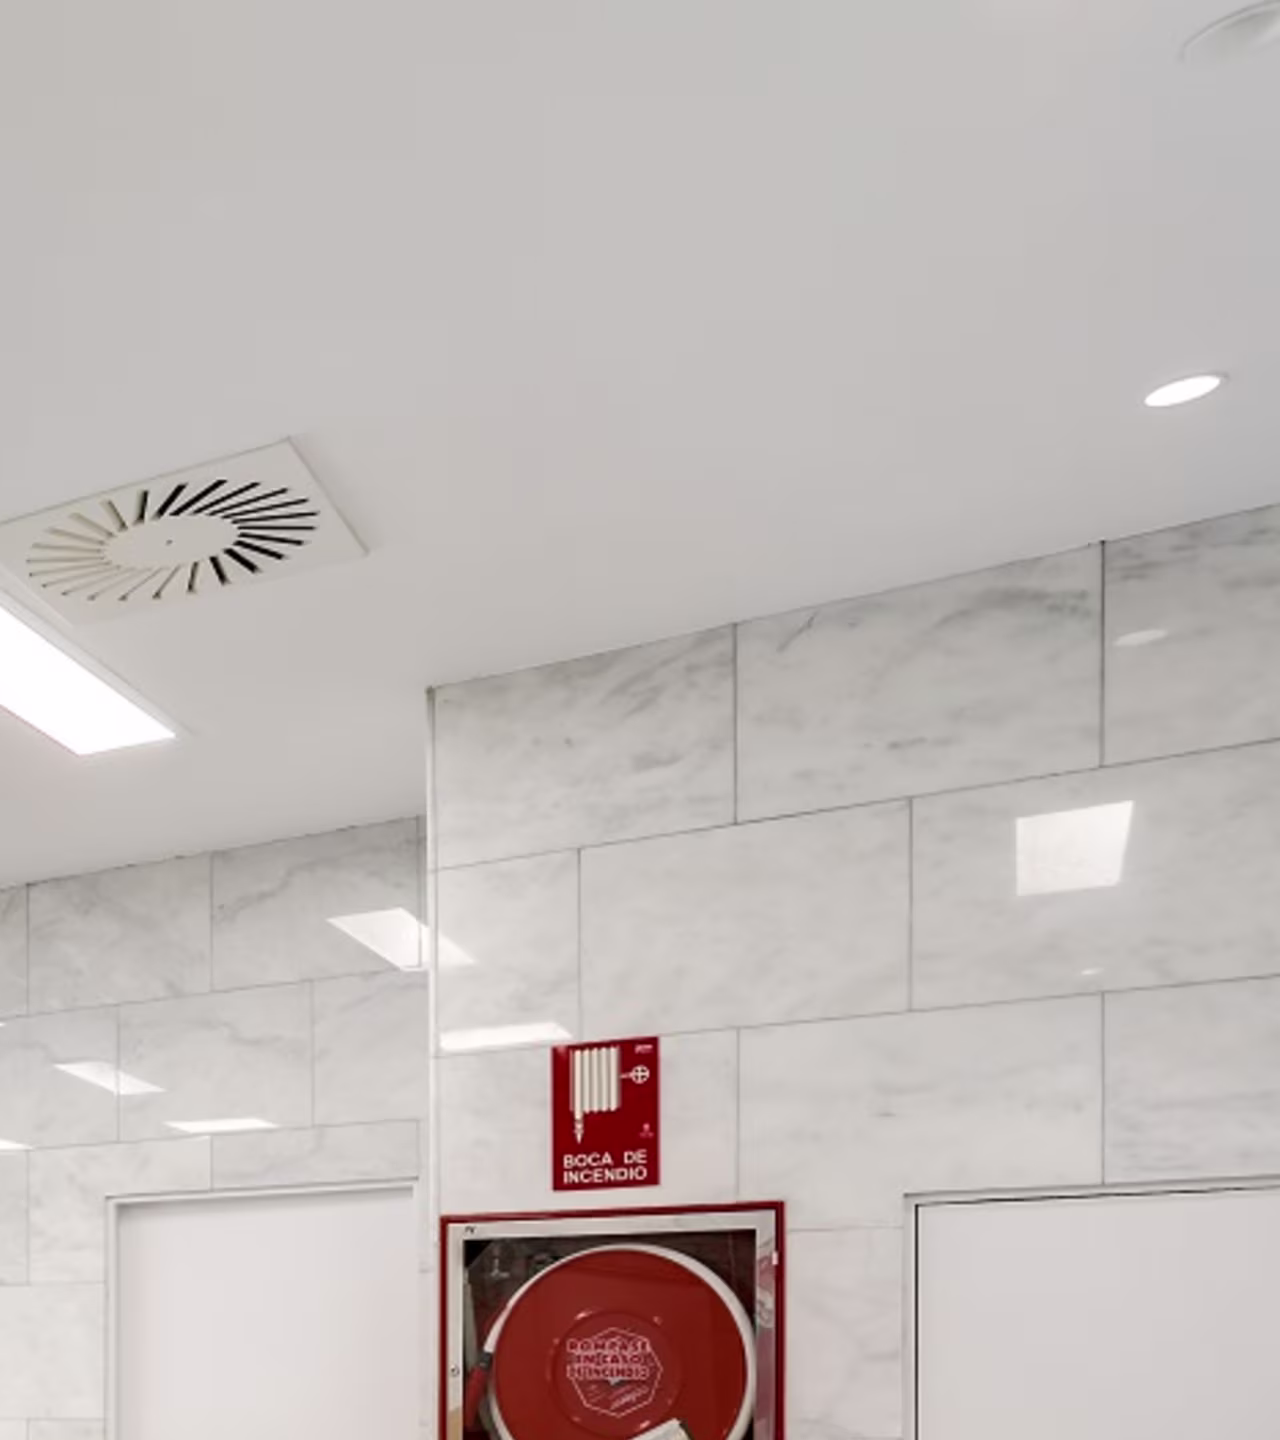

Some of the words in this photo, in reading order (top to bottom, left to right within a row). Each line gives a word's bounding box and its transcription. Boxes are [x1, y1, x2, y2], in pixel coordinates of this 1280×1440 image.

[562, 1151, 614, 1169] BOCA
[623, 1149, 648, 1165] DE
[563, 1166, 648, 1184] INCENDIO
[600, 1353, 643, 1366] CASO
